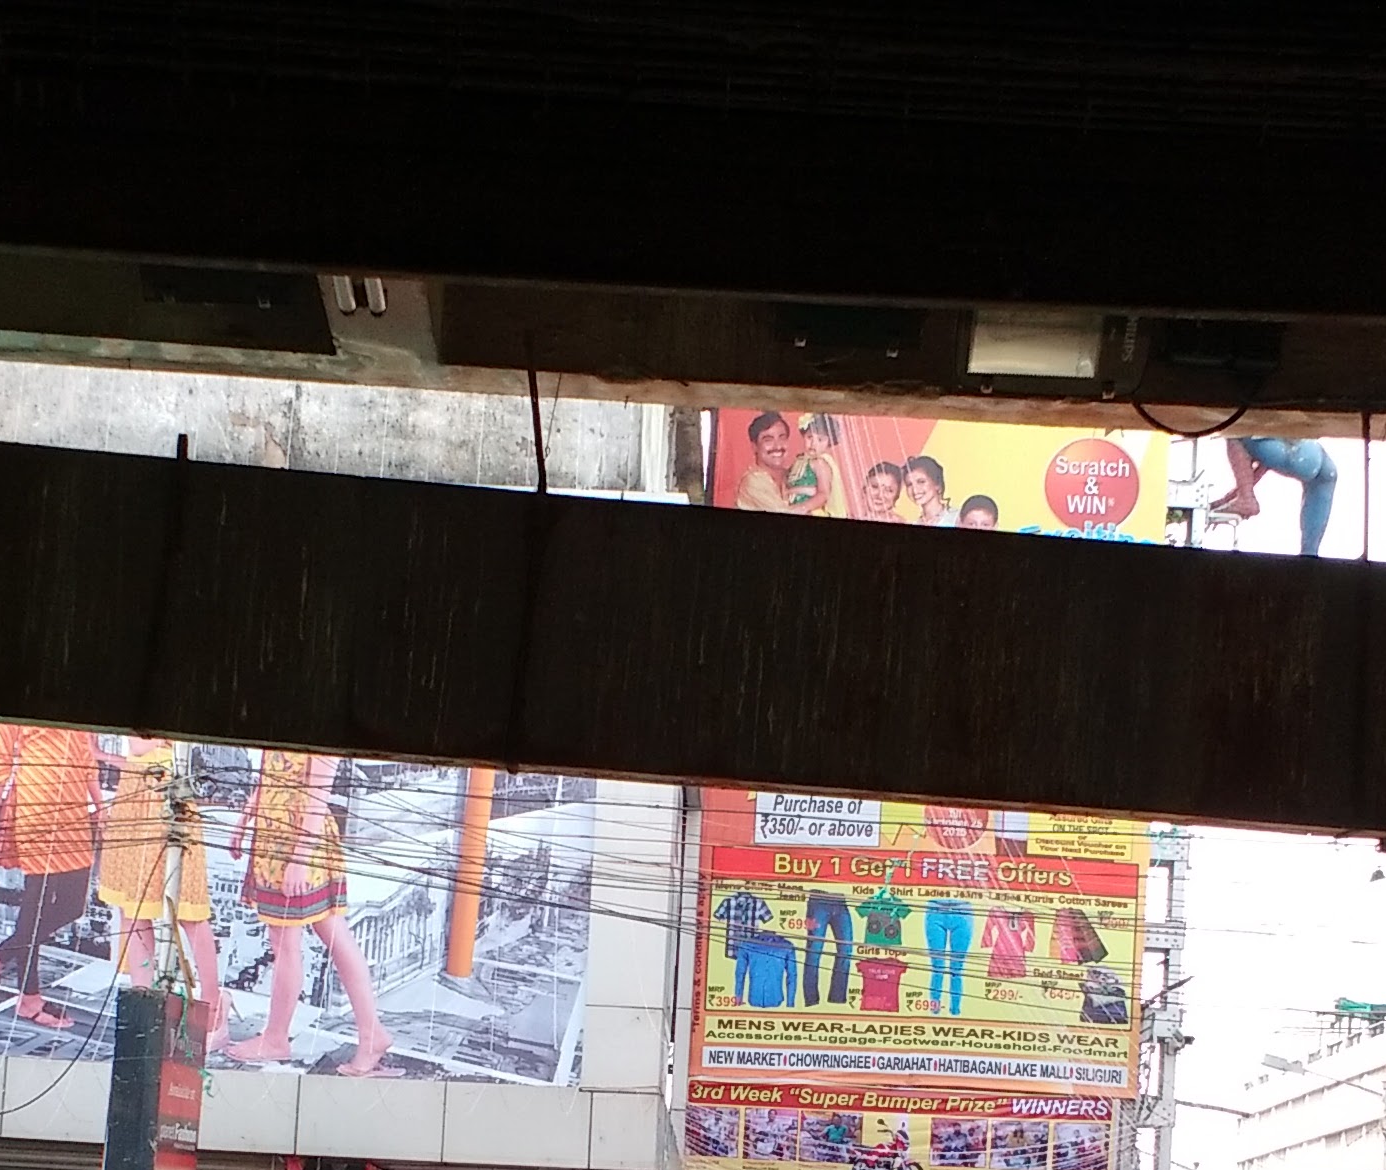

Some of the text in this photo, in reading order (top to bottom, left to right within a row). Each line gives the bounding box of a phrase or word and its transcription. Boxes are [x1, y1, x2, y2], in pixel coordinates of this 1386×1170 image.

[1055, 456, 1130, 477] Scratch
[1084, 476, 1100, 495] &
[773, 795, 863, 814] Purchase of
[760, 815, 874, 838] ₹350/- or above
[774, 853, 821, 877] Buy
[830, 857, 839, 875] 1
[921, 857, 990, 881] FREE
[997, 861, 1073, 887] Offers
[852, 886, 874, 896] Kids
[889, 888, 913, 898] Shirt
[918, 888, 950, 898] Ladies
[1024, 893, 1054, 904] Kurtis
[1058, 896, 1091, 906] Cotton
[856, 947, 881, 957] Girls
[717, 1019, 1119, 1048] MENS WEAR-LADIES WEAR-KIDS WEAR
[708, 1050, 734, 1064] NEW
[737, 1051, 783, 1067] MARKET
[788, 1053, 871, 1069] CHOWRINGHEE
[877, 1058, 933, 1072] GARIAHAT
[938, 1059, 1002, 1075] HATIBAGAN
[1008, 1065, 1037, 1078] LAKE
[1040, 1067, 1070, 1081] MALL
[691, 1084, 1108, 1116] 3rd Week “Super Bumper Prize” WINNERS
